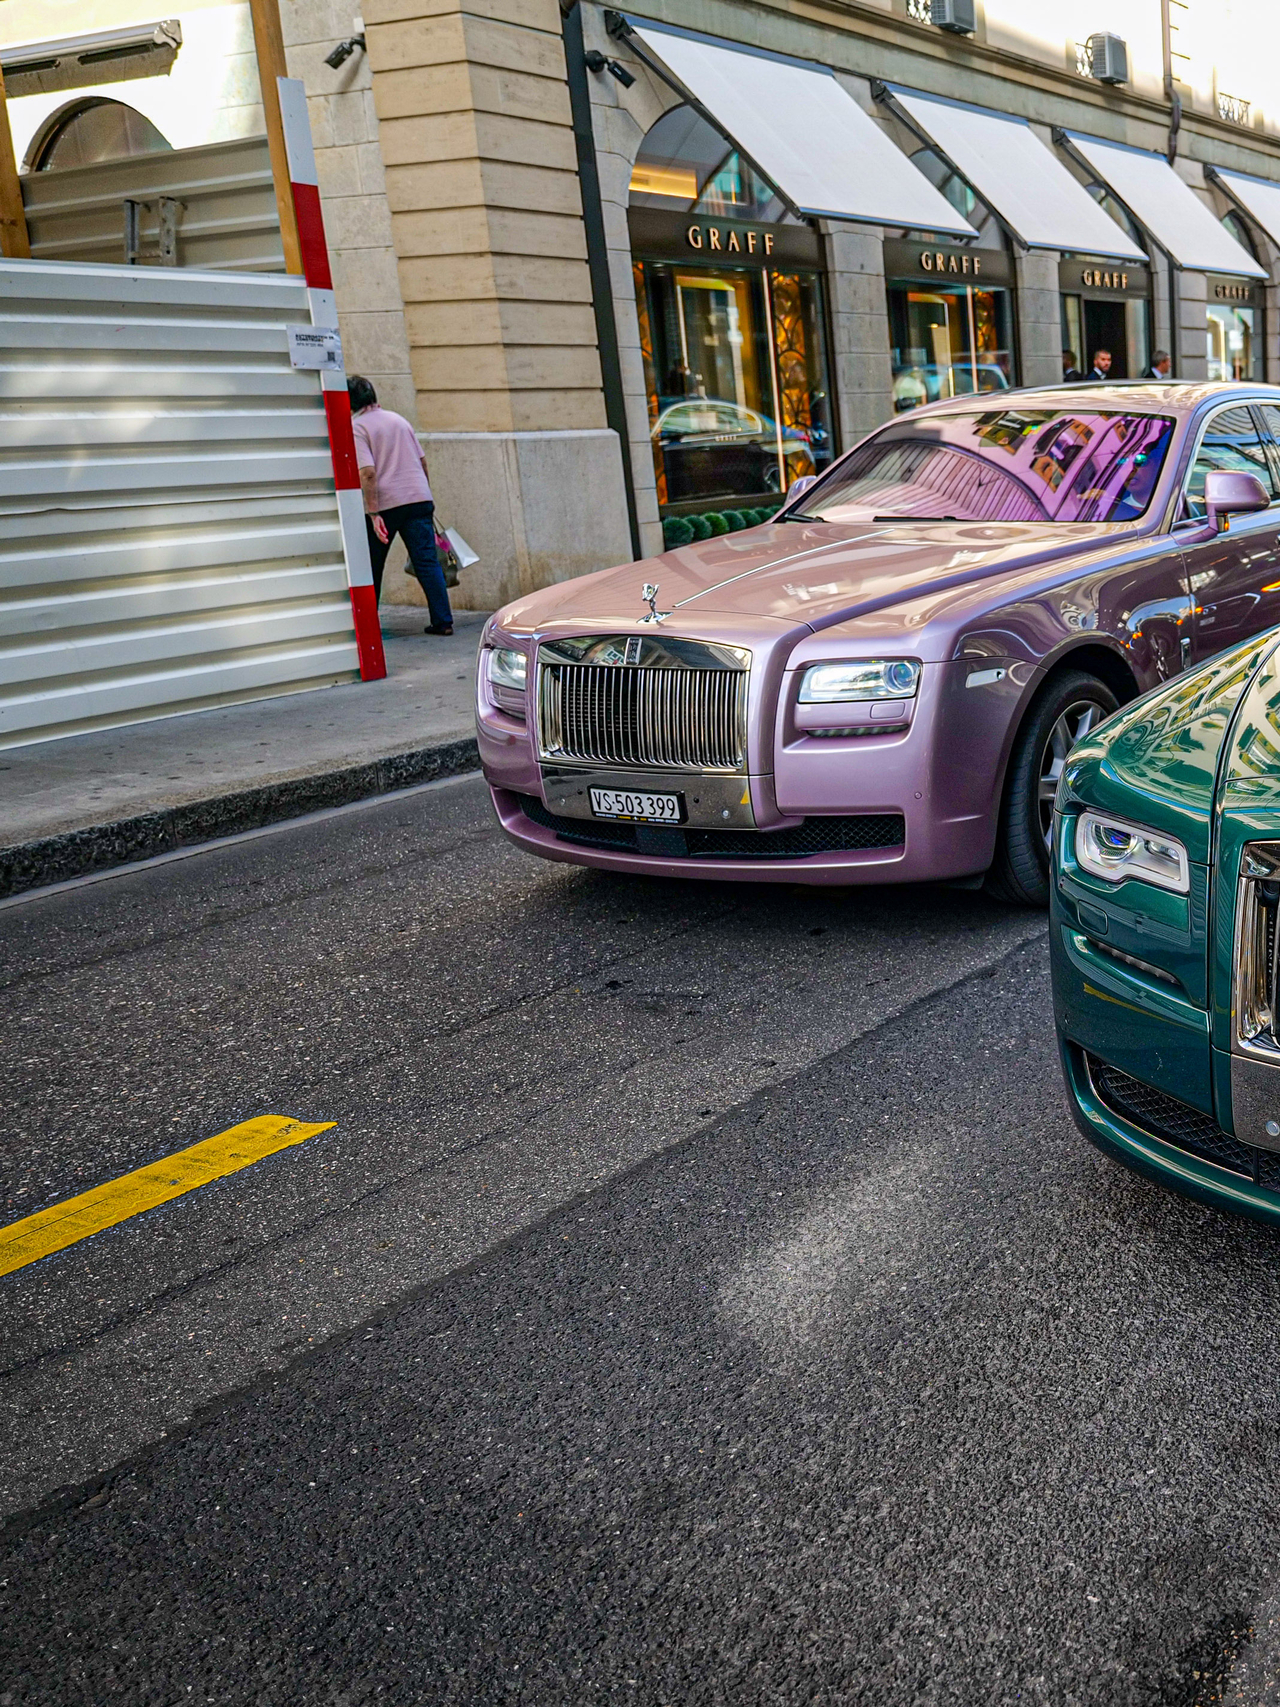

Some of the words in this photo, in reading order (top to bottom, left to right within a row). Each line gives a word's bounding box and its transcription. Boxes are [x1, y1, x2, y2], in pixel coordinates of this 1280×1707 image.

[687, 225, 774, 255] GRAFF
[920, 251, 982, 275] GRAFF
[1082, 269, 1129, 289] GRAFF
[1215, 284, 1249, 300] GRAFF
